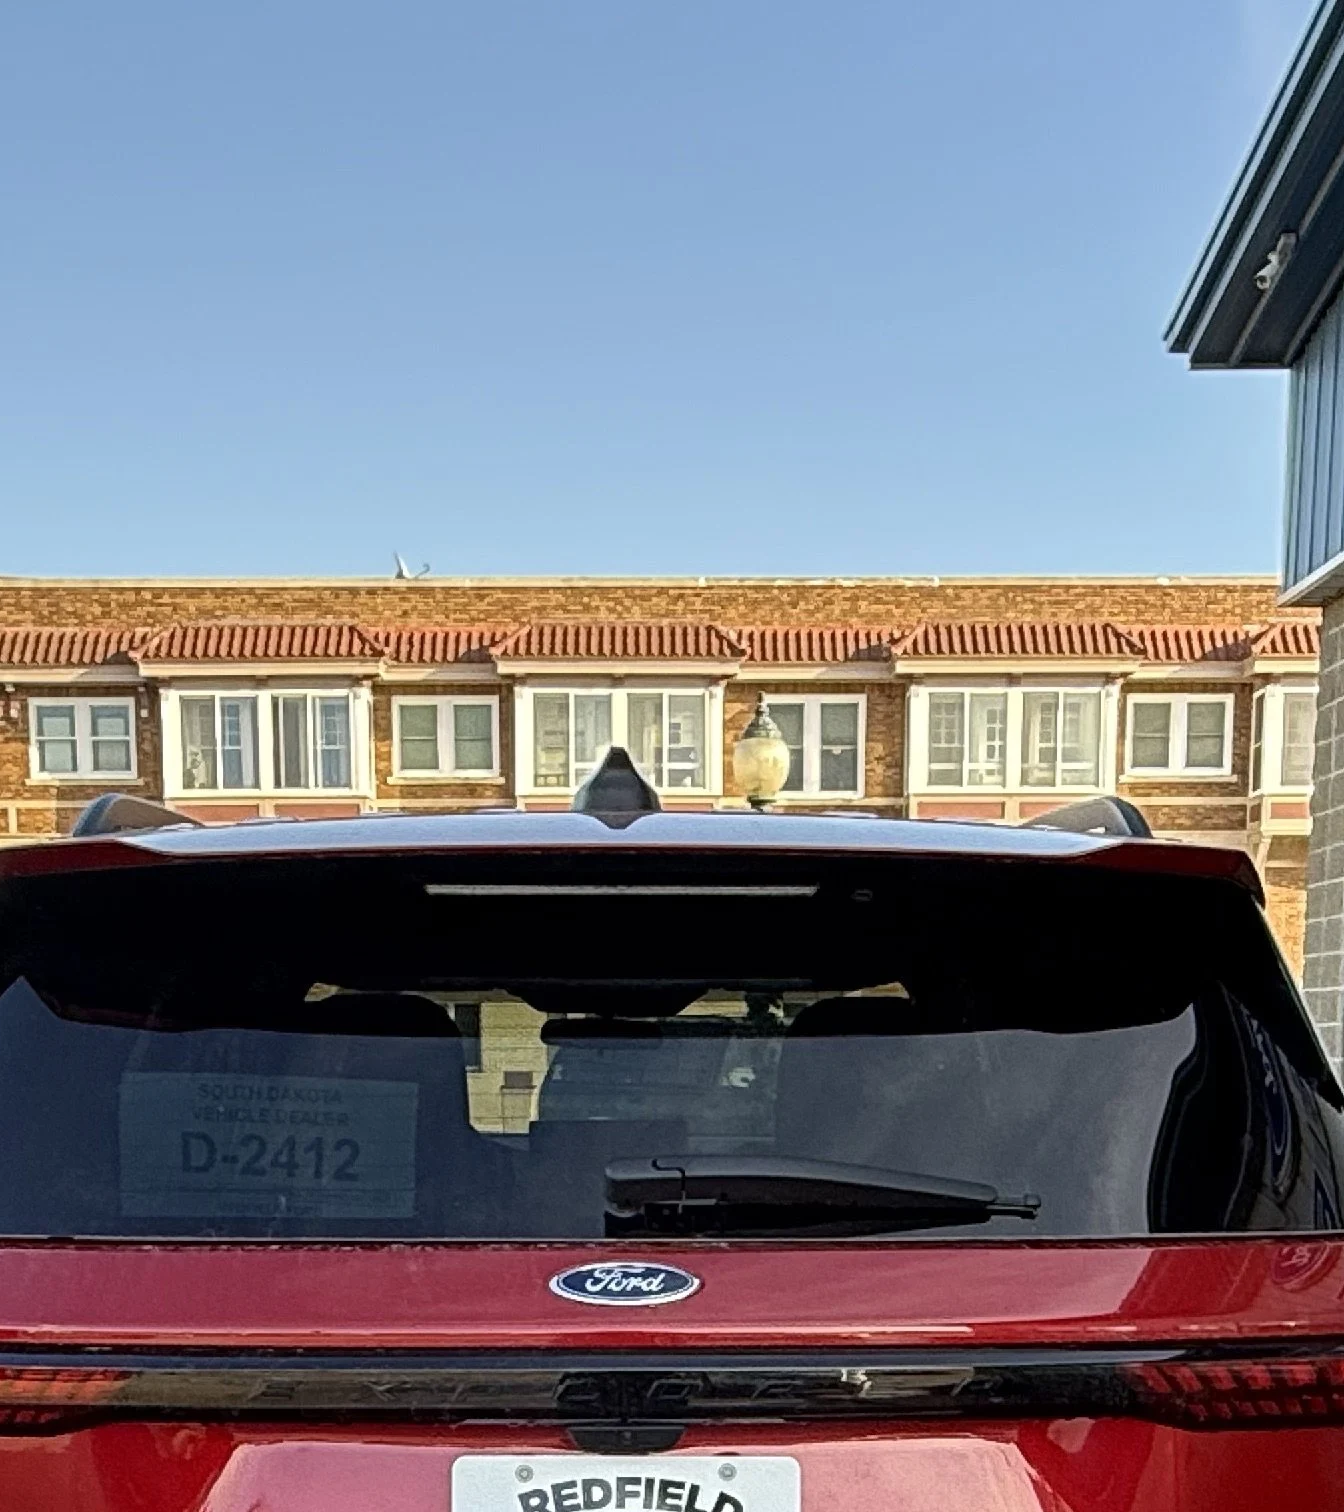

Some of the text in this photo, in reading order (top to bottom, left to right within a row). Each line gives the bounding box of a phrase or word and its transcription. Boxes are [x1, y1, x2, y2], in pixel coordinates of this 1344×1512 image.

[266, 1085, 344, 1104] DAKOTA
[180, 1129, 361, 1182] D-2412
[583, 1266, 665, 1293] Ford
